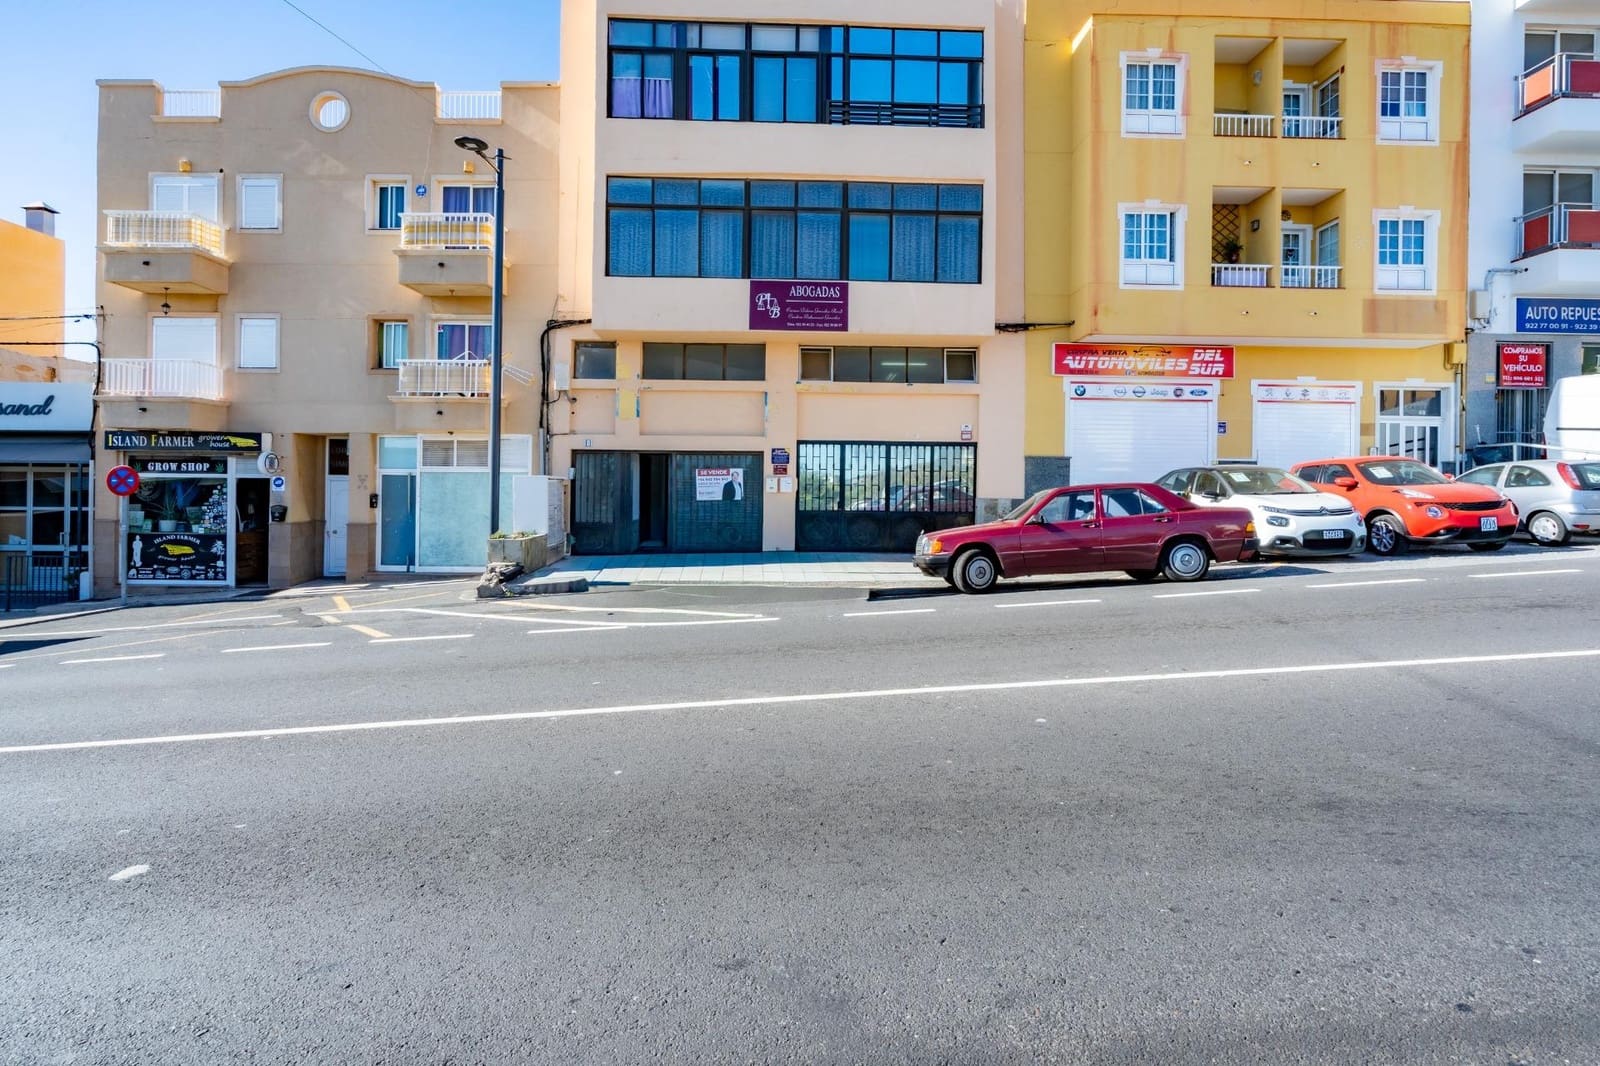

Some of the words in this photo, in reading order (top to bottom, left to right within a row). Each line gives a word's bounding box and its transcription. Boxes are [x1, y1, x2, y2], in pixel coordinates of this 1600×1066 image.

[789, 285, 840, 298] ABOGADAS
[1525, 306, 1558, 320] AUTO
[1192, 349, 1225, 361] DEL
[1518, 354, 1528, 362] SU
[1188, 363, 1225, 376] SUR
[1503, 362, 1543, 372] VEHÍCULO
[108, 434, 148, 447] ISLAND
[151, 435, 195, 448] FARMER
[198, 434, 225, 443] grower
[209, 440, 230, 448] house
[147, 462, 178, 472] GROW
[180, 462, 210, 472] SHOP
[153, 535, 176, 545] ISLAND
